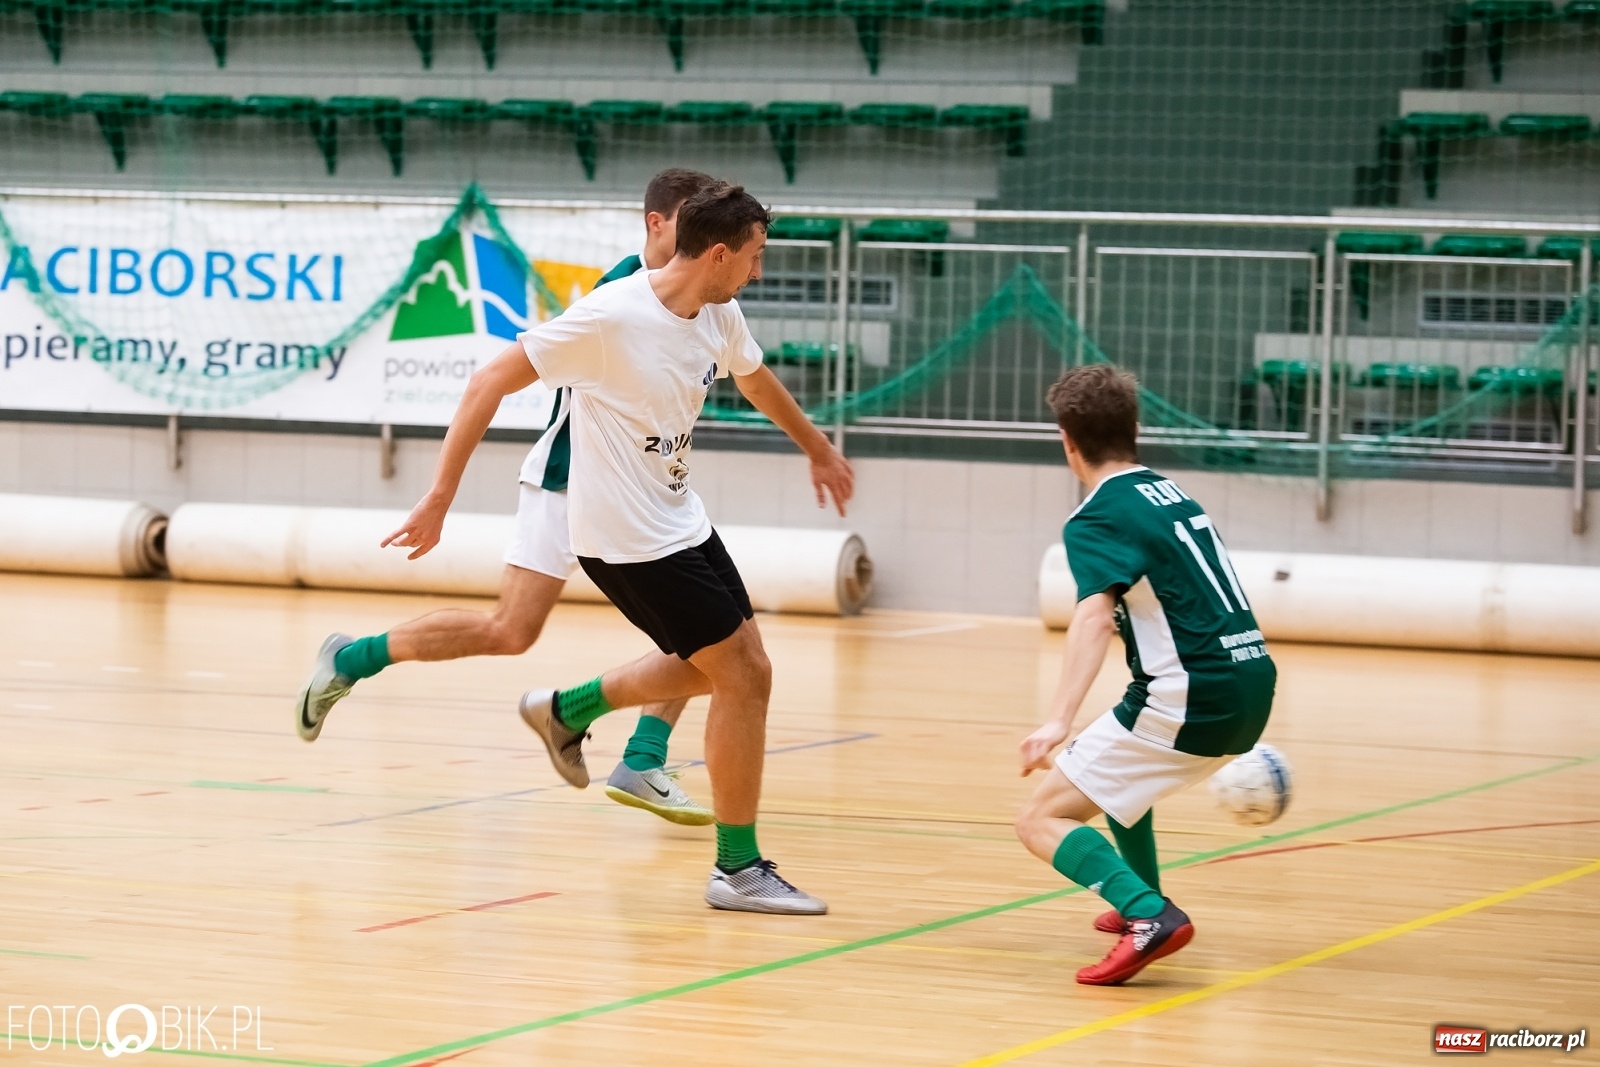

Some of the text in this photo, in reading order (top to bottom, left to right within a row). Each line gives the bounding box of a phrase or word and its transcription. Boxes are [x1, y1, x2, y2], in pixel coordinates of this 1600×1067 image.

[0, 246, 343, 301] ACIBORSKI
[0, 325, 347, 380] pieramy, gramy
[384, 351, 477, 384] powiat
[1173, 514, 1249, 613] 17
